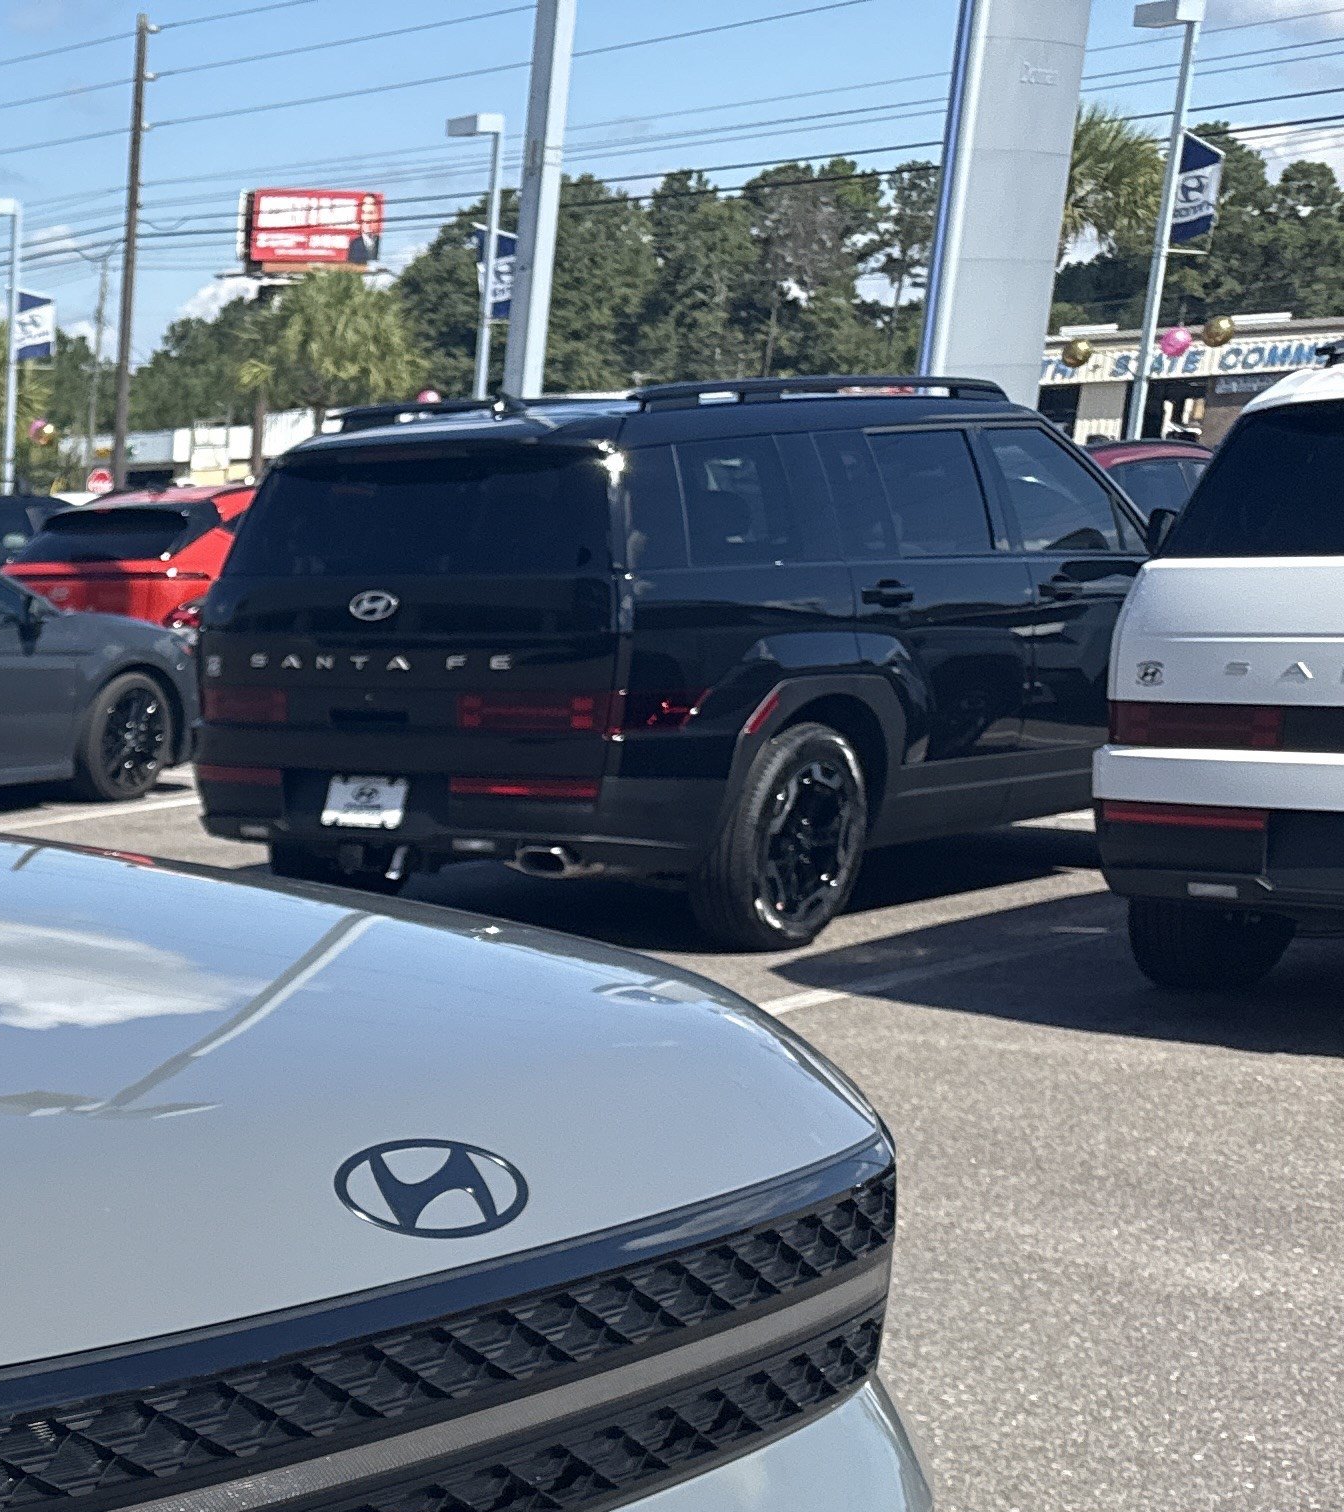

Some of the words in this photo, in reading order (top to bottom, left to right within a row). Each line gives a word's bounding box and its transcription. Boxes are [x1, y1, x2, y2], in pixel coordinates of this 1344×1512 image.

[250, 653, 410, 670] SANTA
[445, 654, 512, 670] FE
[1225, 661, 1344, 685] SA
